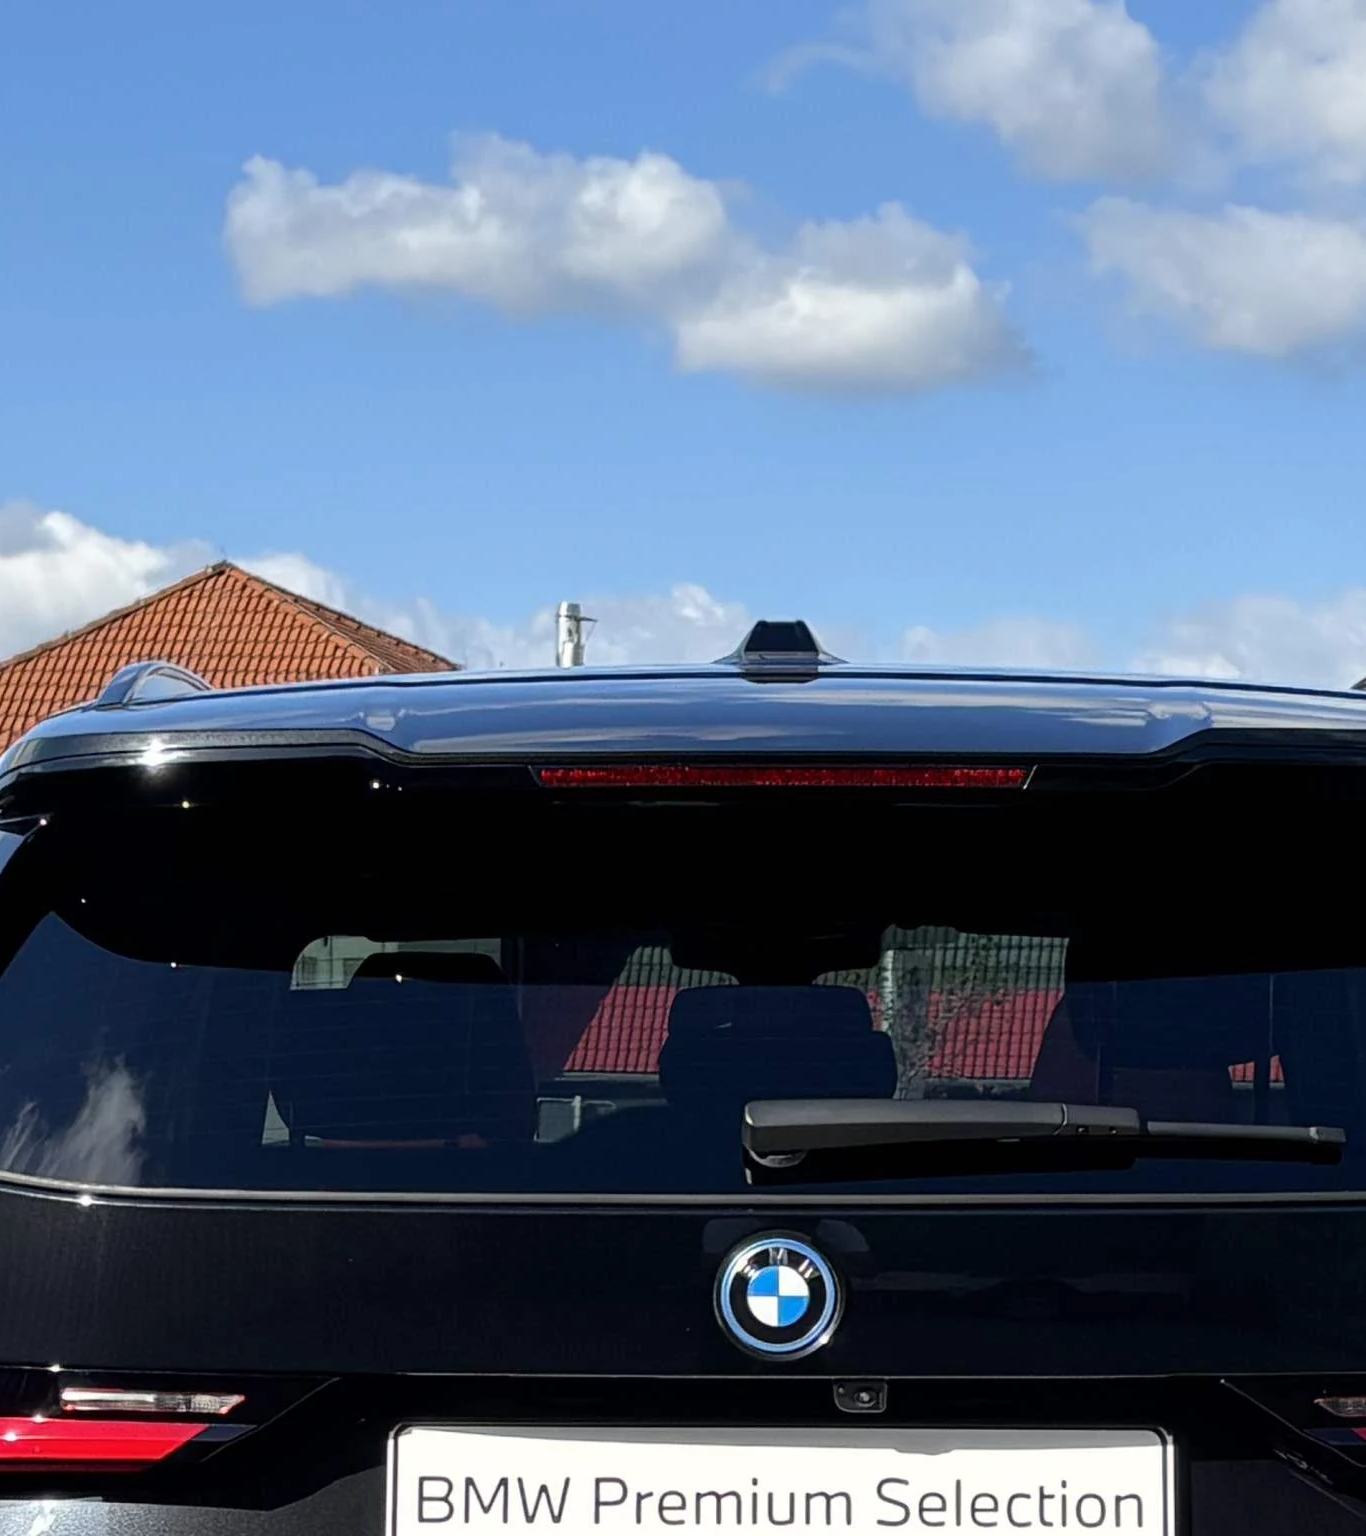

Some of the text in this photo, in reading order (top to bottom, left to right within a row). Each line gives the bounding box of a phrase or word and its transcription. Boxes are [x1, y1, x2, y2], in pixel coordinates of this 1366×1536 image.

[418, 1476, 1143, 1528] BMW Premium Selection
